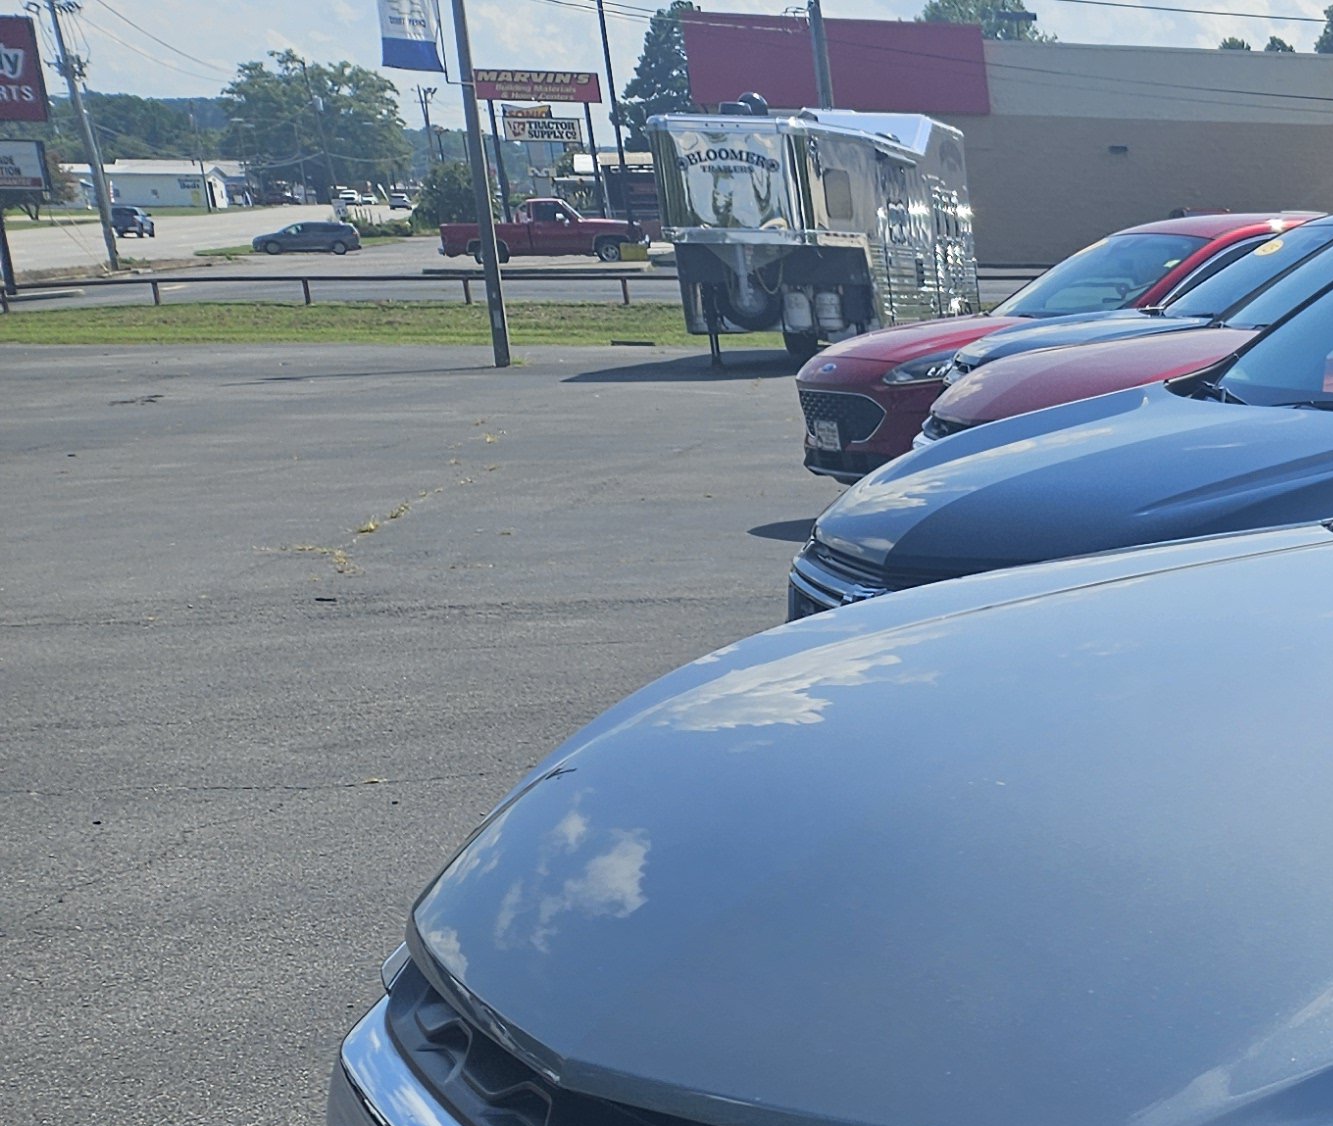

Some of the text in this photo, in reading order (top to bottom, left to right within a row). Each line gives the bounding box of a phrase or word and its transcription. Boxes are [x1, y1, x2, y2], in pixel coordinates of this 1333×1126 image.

[477, 70, 590, 84] MARVIN'S
[495, 83, 577, 94] Building Materials
[539, 93, 575, 101] Centers
[527, 120, 575, 131] TRACTOR
[527, 130, 565, 140] SUPPLY
[684, 147, 766, 169] BLOOMER
[699, 164, 755, 174] TRAILERS
